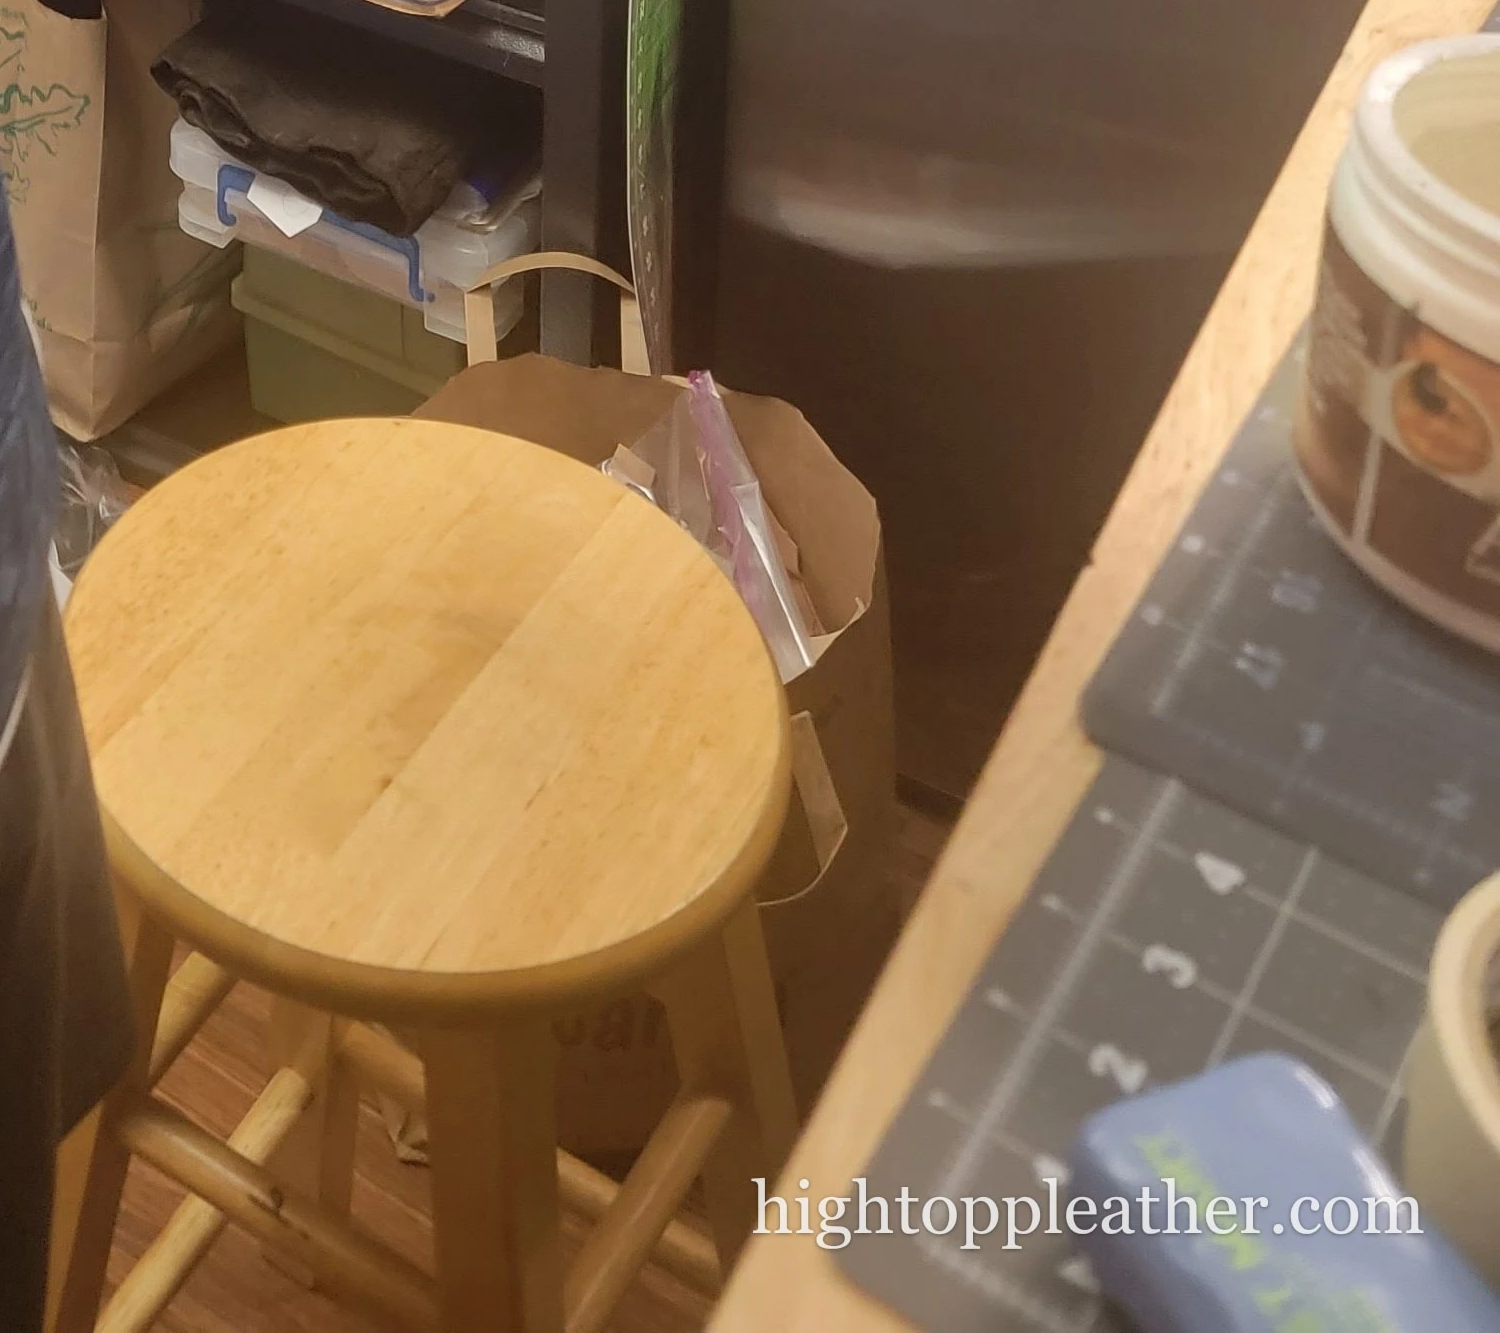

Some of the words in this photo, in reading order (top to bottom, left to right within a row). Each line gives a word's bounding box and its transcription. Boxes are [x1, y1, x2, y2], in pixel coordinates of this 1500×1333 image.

[1088, 1042, 1147, 1095] 2
[1141, 943, 1197, 989] 3
[1195, 850, 1246, 895] 4
